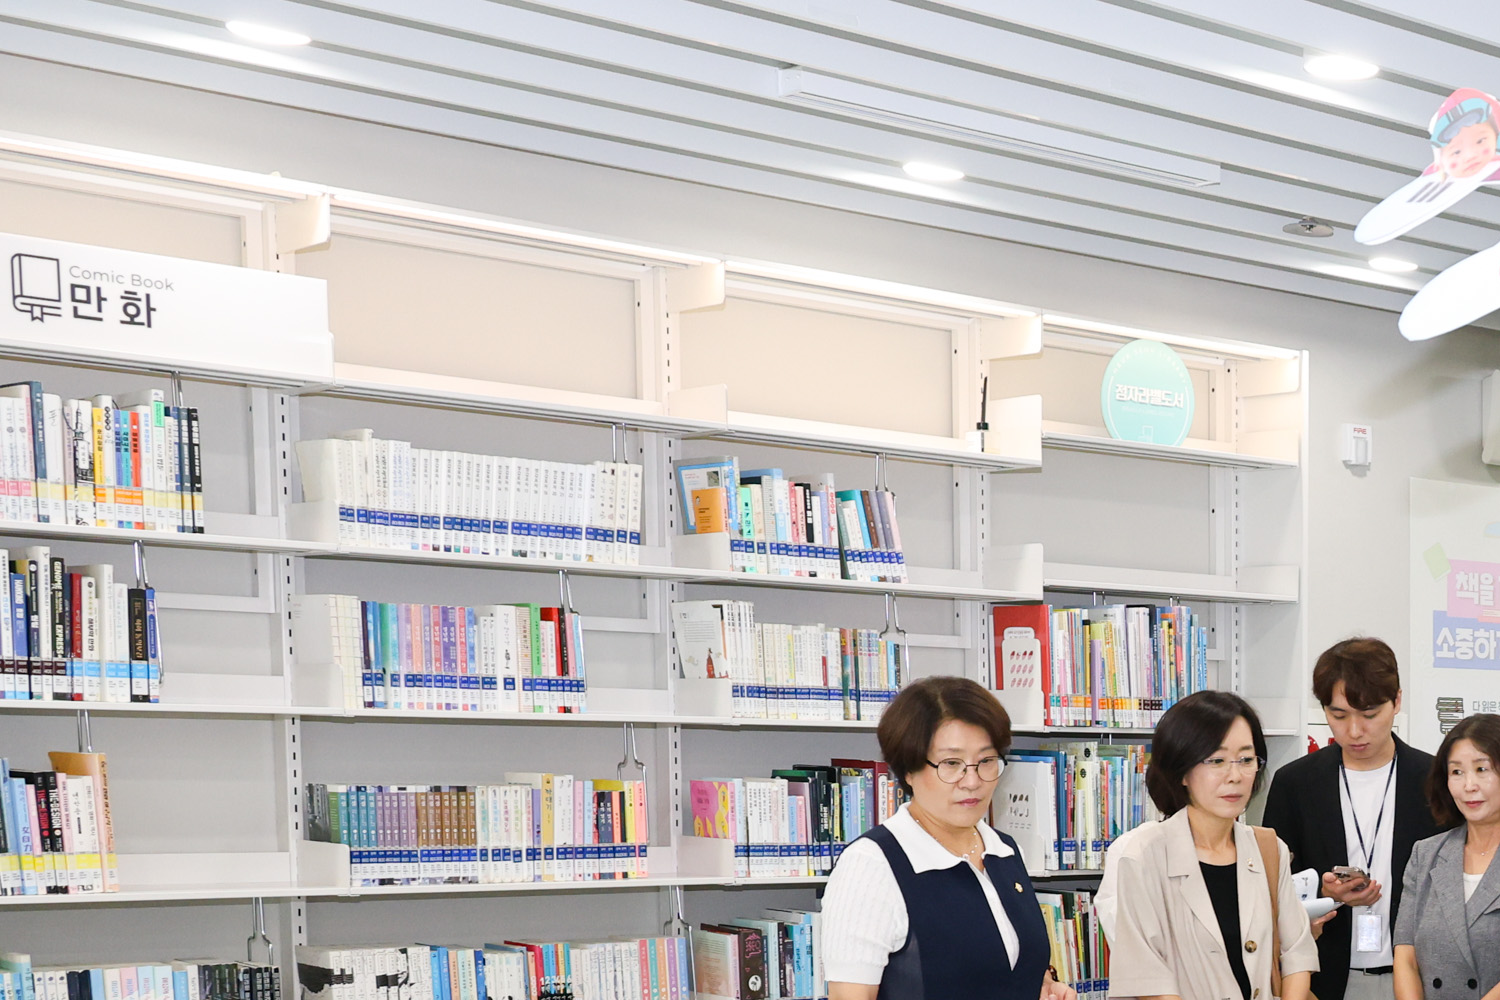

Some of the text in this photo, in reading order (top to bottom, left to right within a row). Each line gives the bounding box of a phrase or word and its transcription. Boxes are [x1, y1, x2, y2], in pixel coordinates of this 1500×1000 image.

[68, 264, 175, 293] Comic Book
[1114, 383, 1185, 409] 점자라벨도서
[53, 560, 63, 591] GENOME
[1455, 570, 1495, 607] 책을
[55, 624, 64, 656] EXPRESS
[1472, 700, 1480, 712] 다
[1481, 700, 1497, 713] 읽은
